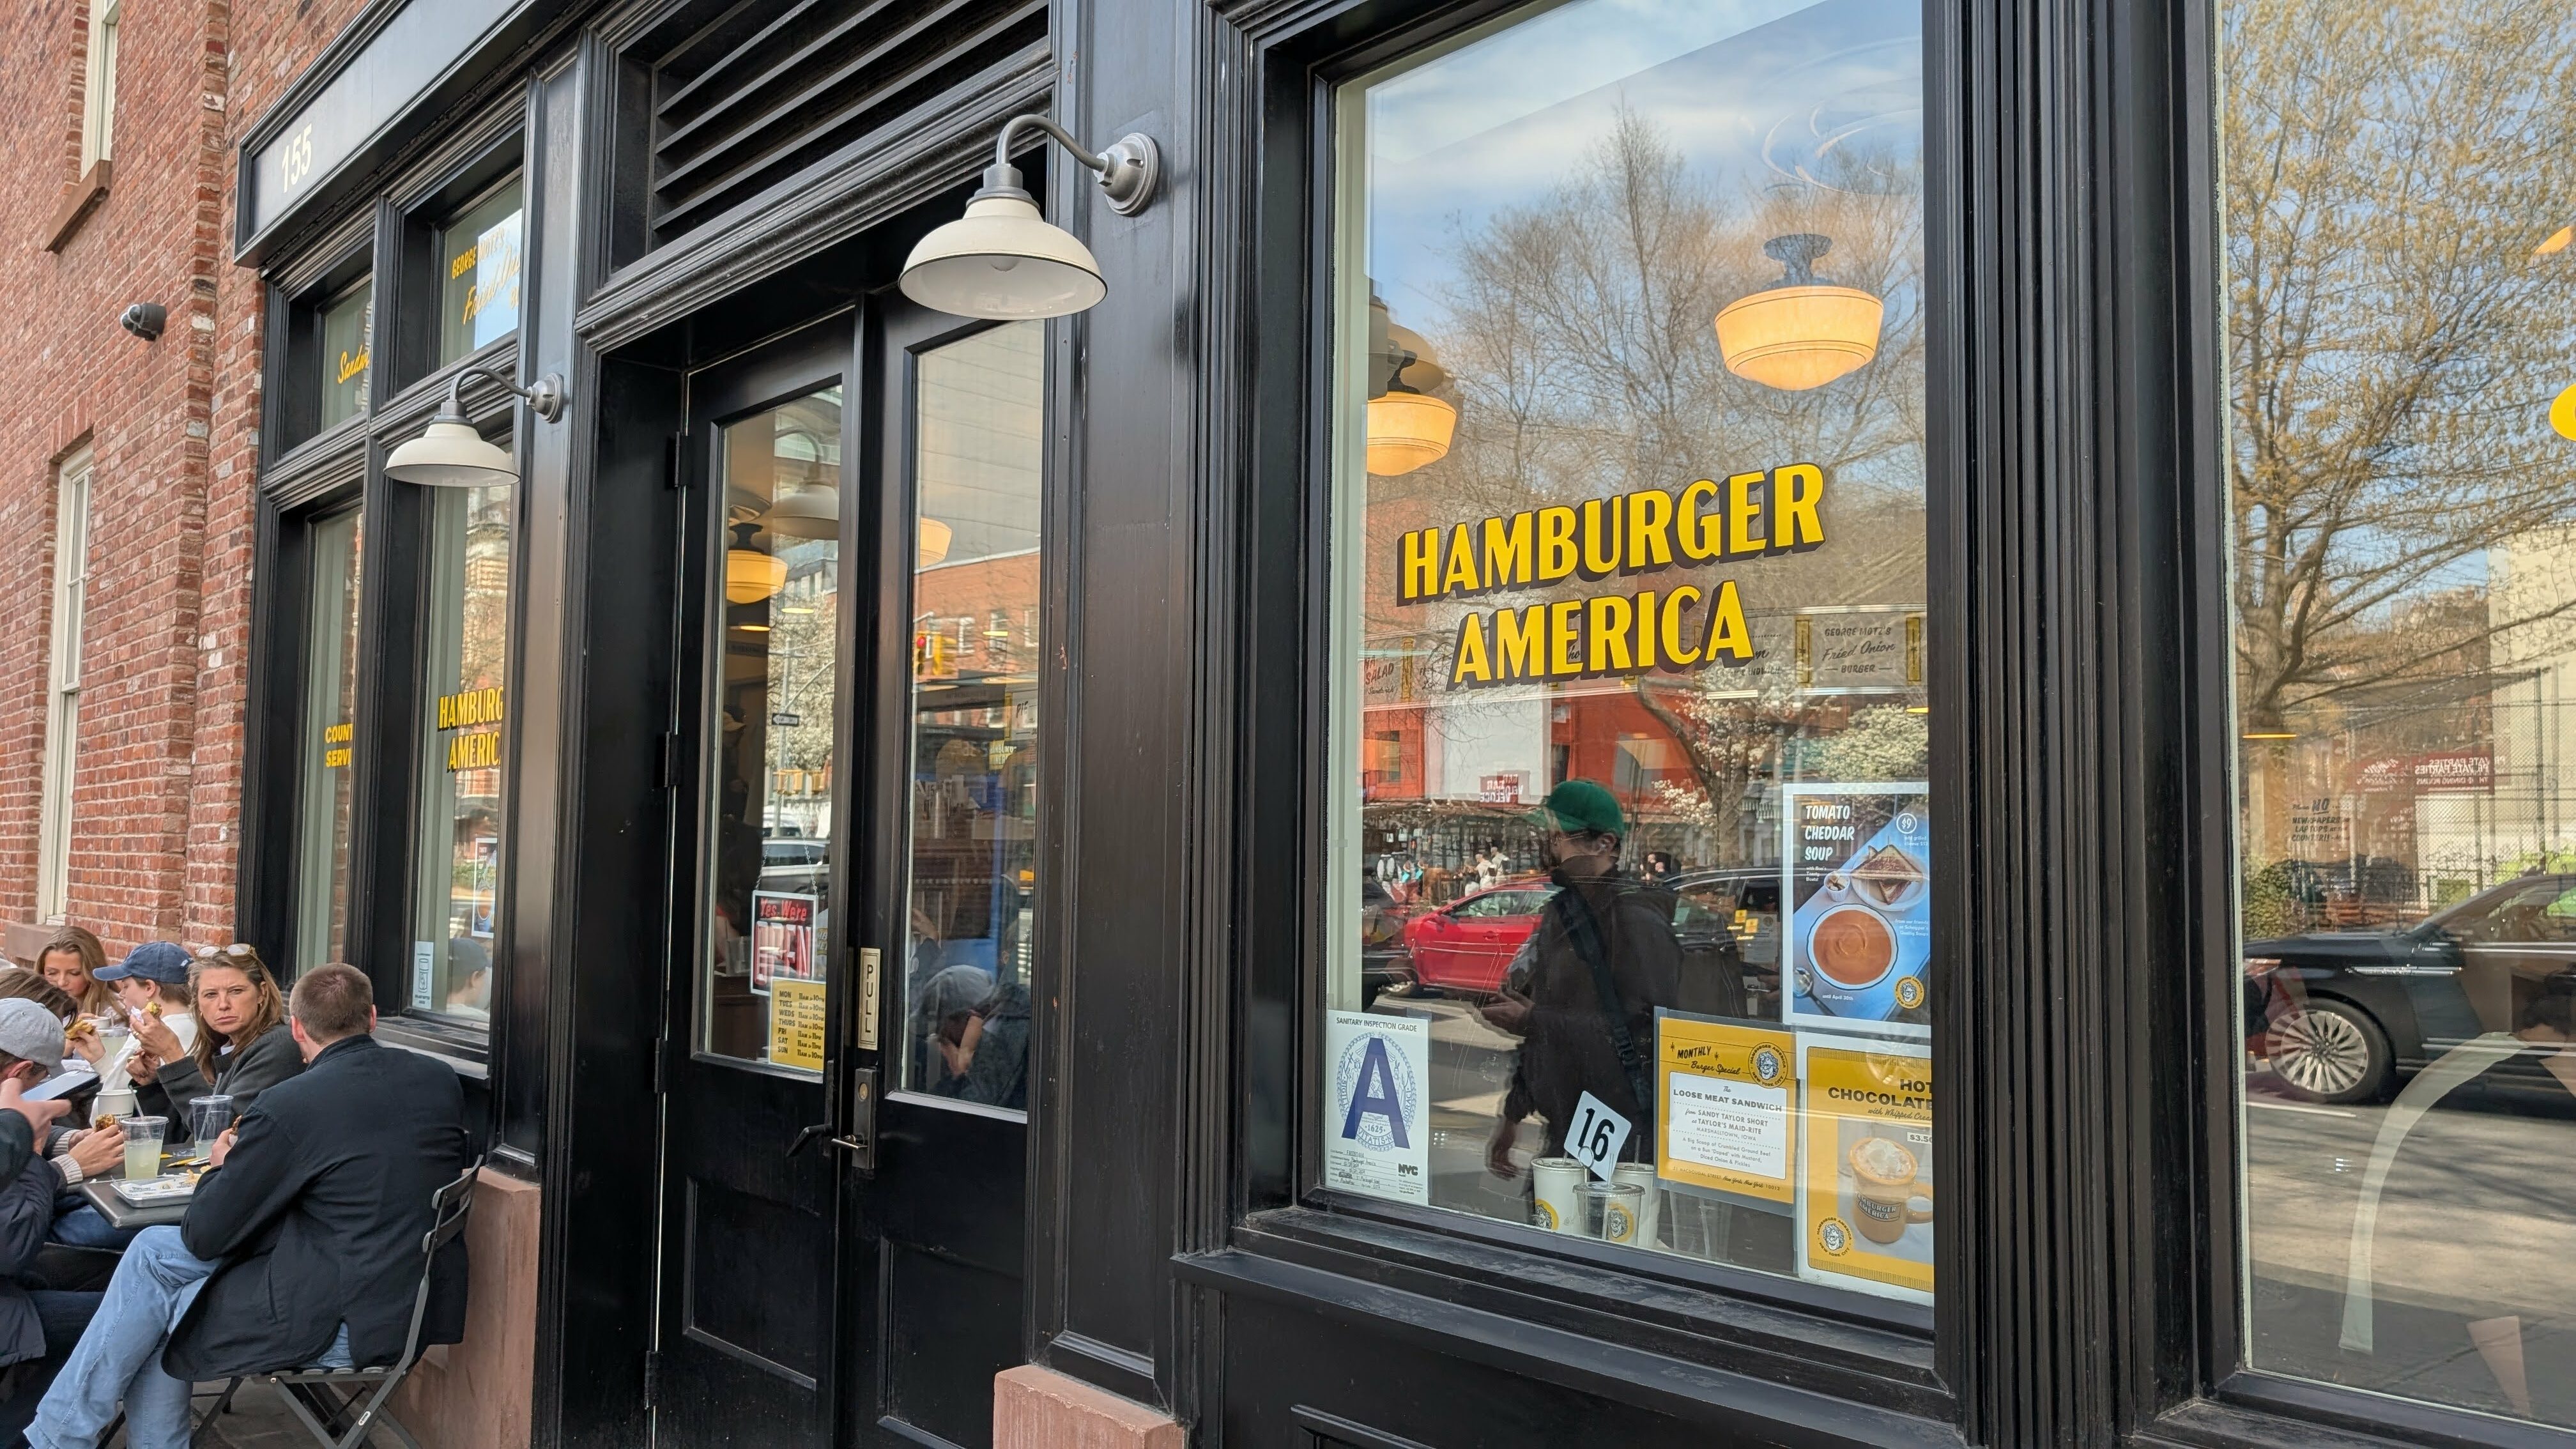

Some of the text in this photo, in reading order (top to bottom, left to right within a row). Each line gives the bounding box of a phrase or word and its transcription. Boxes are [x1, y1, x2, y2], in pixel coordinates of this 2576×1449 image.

[282, 123, 312, 193] 155
[451, 245, 477, 280] GEORGE
[1397, 462, 1826, 607] HAMBURGER
[1446, 579, 1755, 691] AMERICA
[1825, 627, 1856, 636] GEORGE
[1822, 640, 1896, 661] Fried Onion
[1365, 663, 1394, 685] SALAD
[1841, 664, 1875, 673] BURGER
[438, 686, 503, 732] HAMBURG
[325, 723, 353, 744] COUNT
[447, 731, 500, 772] AMERIC
[1805, 805, 1850, 820] TOMATO
[2312, 798, 2330, 812] NO
[1902, 818, 1912, 829] $9
[1805, 825, 1855, 841] CHEDDAR
[1804, 846, 1834, 861] SOUP
[755, 921, 811, 985] OPEN
[865, 964, 874, 1033] PULL
[779, 1009, 795, 1017] WEDS
[778, 1018, 795, 1027] THURS
[1337, 1017, 1417, 1032] SANITARY INSPECTION GRADE
[1677, 1045, 1712, 1059] MONTHLY
[1750, 1045, 1771, 1064] HAMBURGER
[1691, 1061, 1741, 1075] Burger Special
[1775, 1076, 1783, 1085] CITY
[1899, 1078, 1932, 1093] HOT
[1342, 1037, 1411, 1149] A
[1673, 1089, 1782, 1112] LOOSE MEAT SANDWICH
[1828, 1087, 1932, 1110] CHOCOLATE
[1698, 1110, 1719, 1119] SANDY
[1721, 1113, 1745, 1123] TAYLOR
[1747, 1117, 1768, 1127] SHORT
[1885, 1108, 1913, 1119] Whipped
[1367, 1124, 1383, 1133] 1625
[1696, 1127, 1740, 1139] MARSHALLTOWN,
[1698, 1118, 1727, 1128] TAYLOR'S
[1728, 1124, 1762, 1135] MAID-RITE
[1577, 1108, 1615, 1162] 16
[1718, 1143, 1740, 1151] Crumbled
[1742, 1154, 1762, 1163] Mustard,
[1399, 1163, 1418, 1176] NYC
